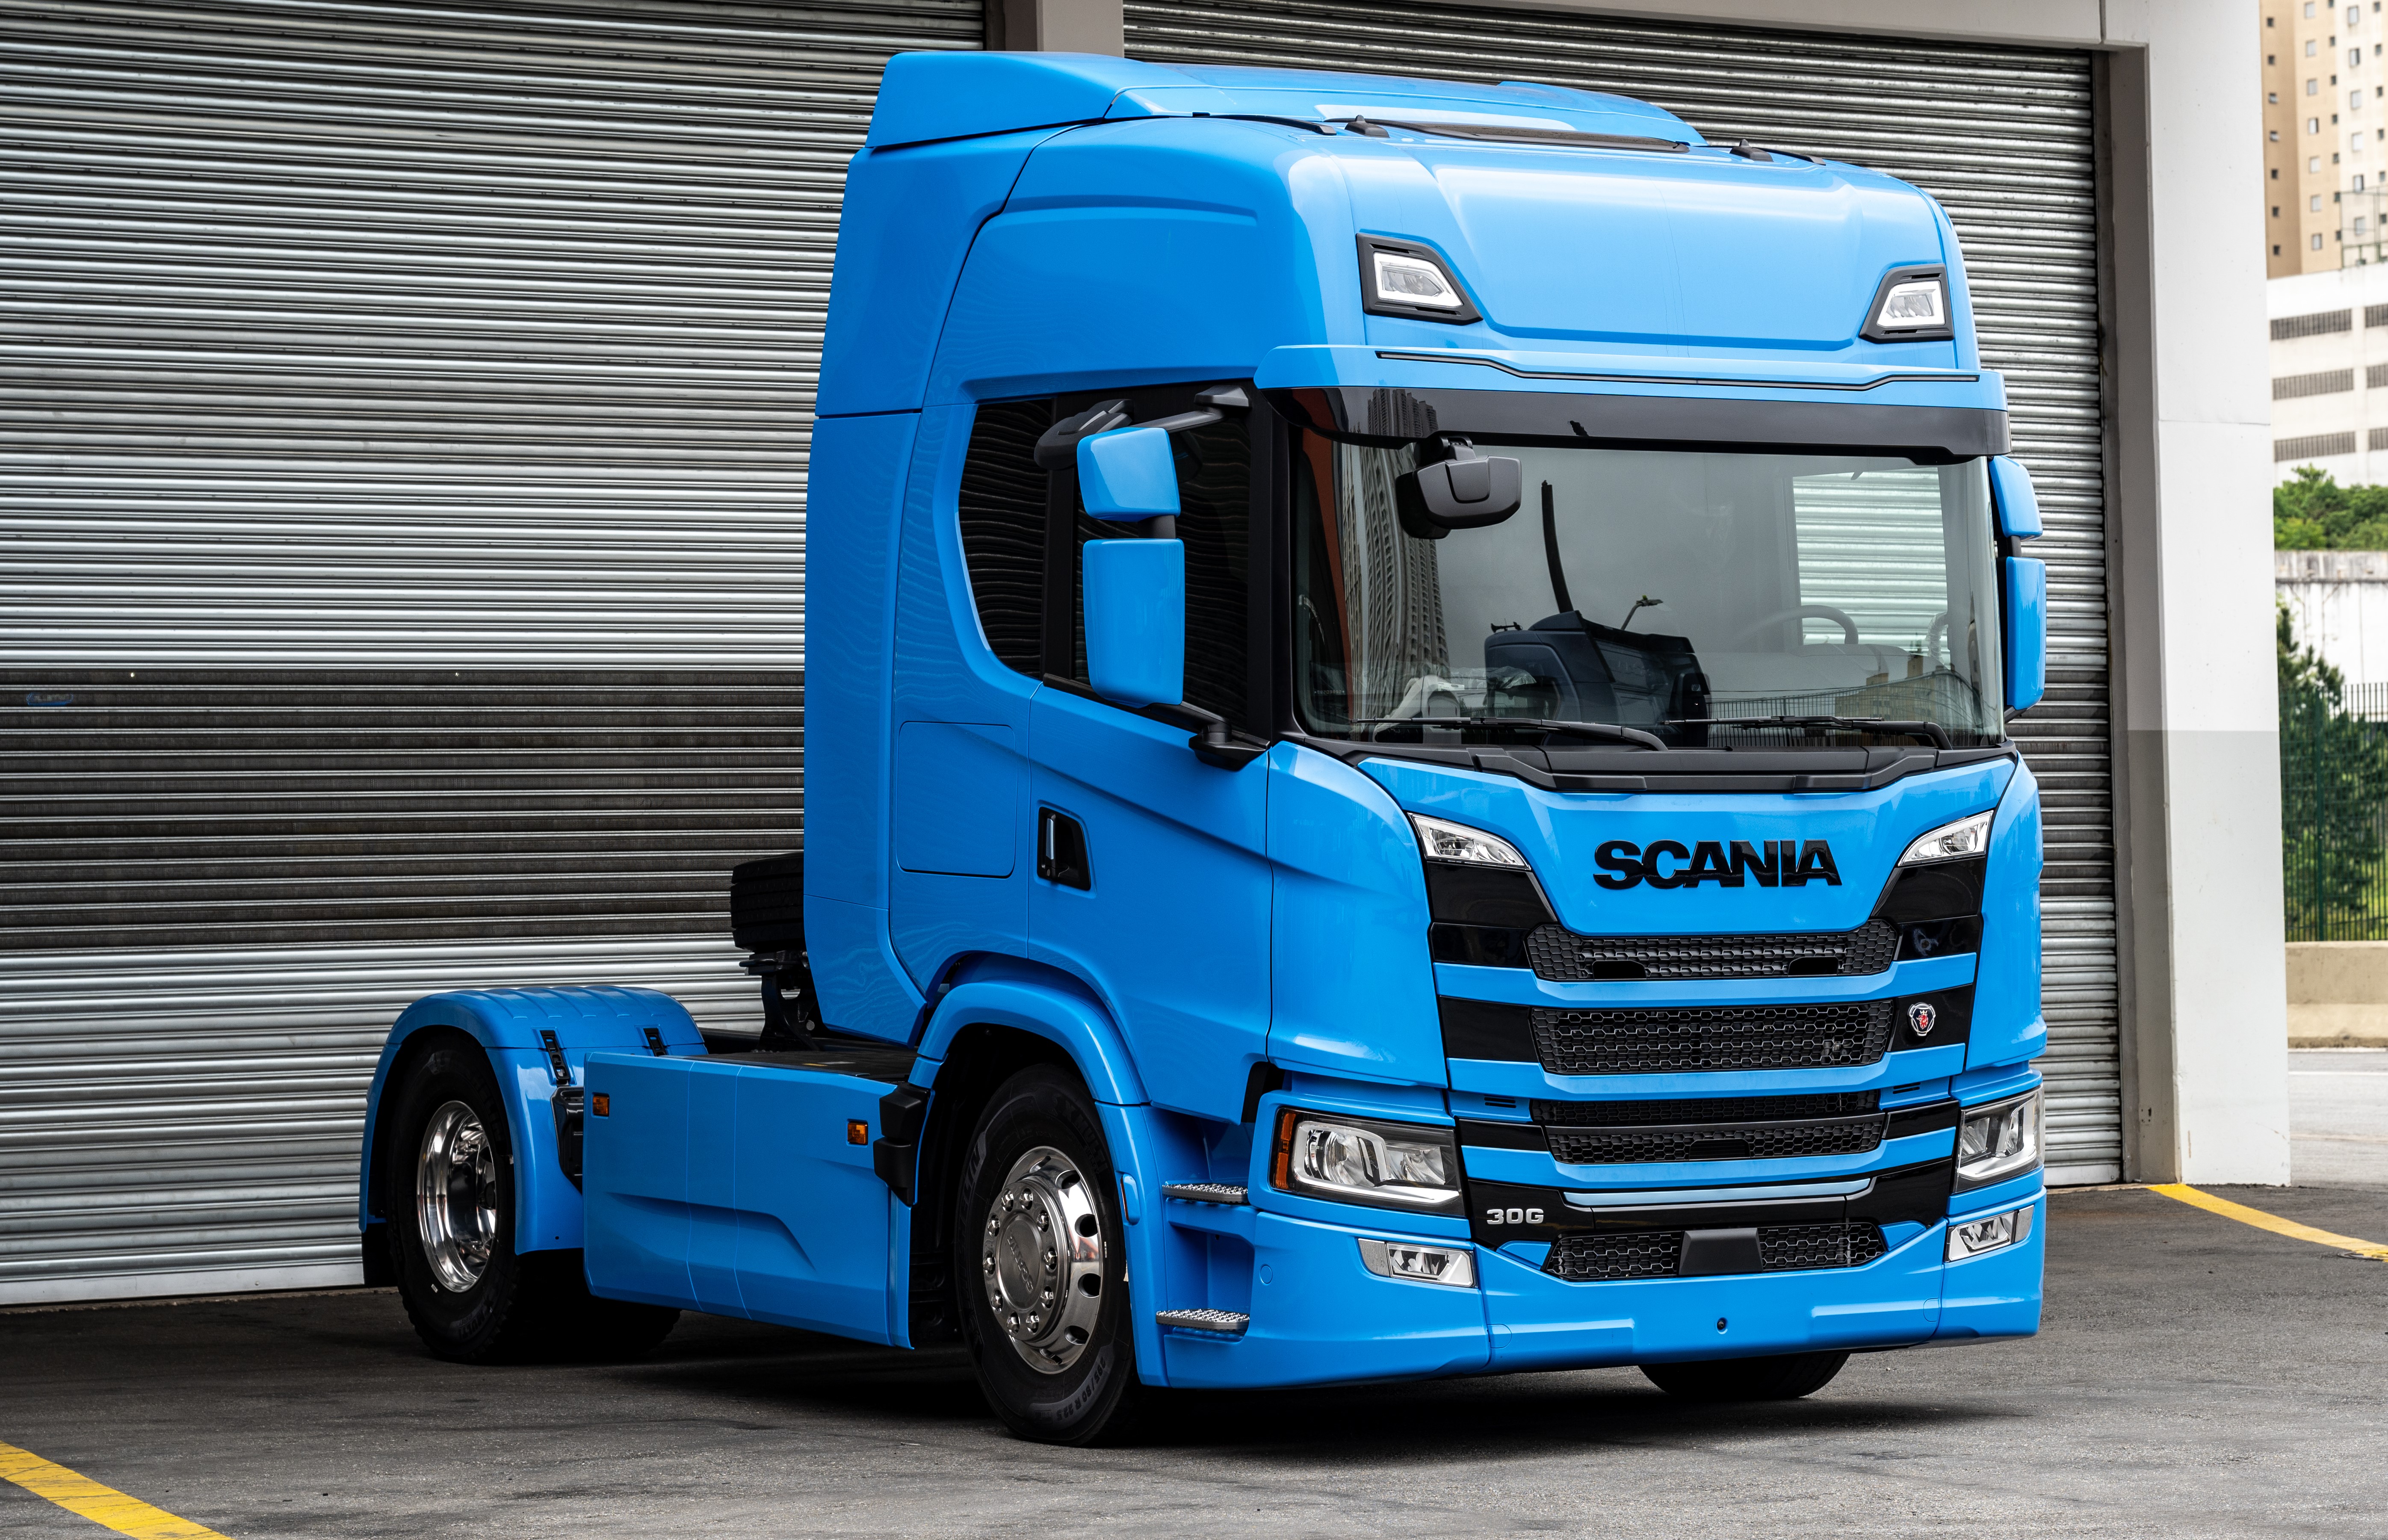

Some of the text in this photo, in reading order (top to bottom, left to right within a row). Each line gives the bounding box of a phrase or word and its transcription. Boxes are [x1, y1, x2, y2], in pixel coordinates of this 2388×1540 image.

[1592, 839, 1842, 890] SCANIA
[1061, 1100, 1109, 1173] X MULTI
[958, 1143, 980, 1310] MICHELIN
[1487, 1208, 1544, 1224] 30G
[1006, 1229, 1034, 1293] SCANIA
[459, 1309, 485, 1340] MULTI
[1082, 1357, 1106, 1402] 295/80
[1056, 1402, 1074, 1421] 22.5
[1074, 1397, 1082, 1410] R
